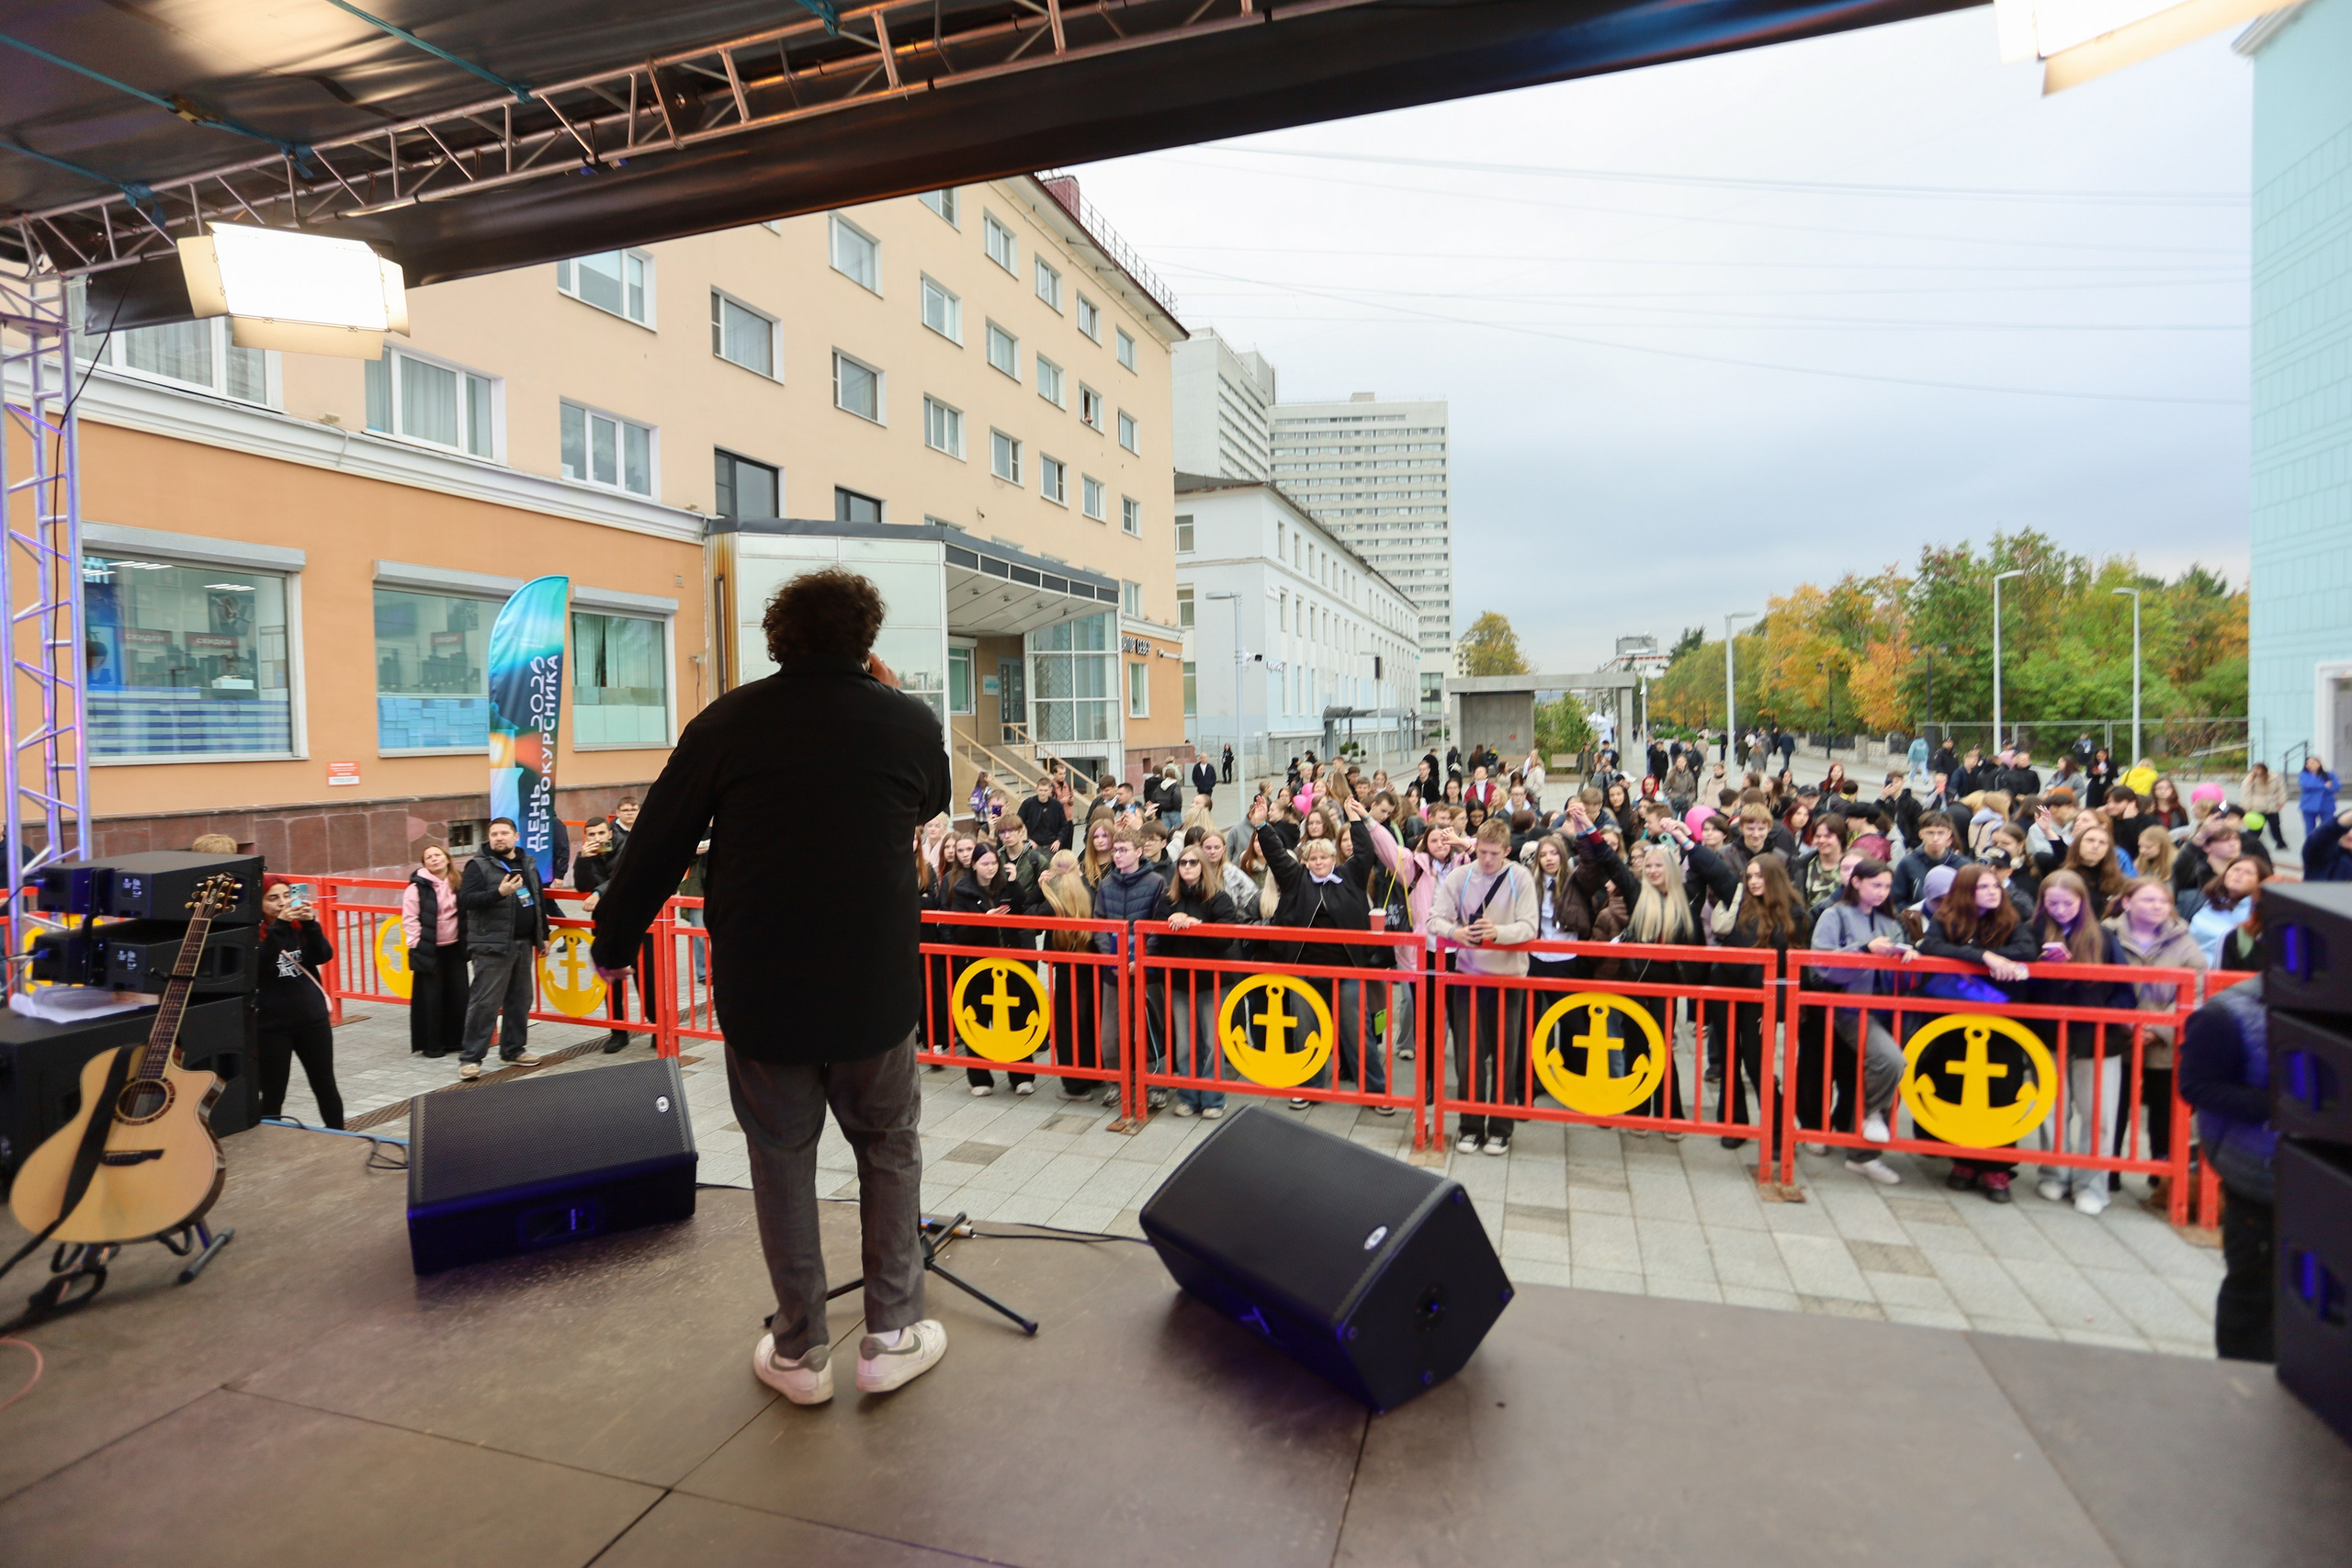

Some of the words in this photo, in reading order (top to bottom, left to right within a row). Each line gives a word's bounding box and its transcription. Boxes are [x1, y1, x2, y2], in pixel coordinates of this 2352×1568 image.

[125, 634, 164, 642] СКИДКИ
[530, 656, 546, 733] 2025
[538, 655, 559, 851] ПЕРВОКУРСНИКА
[526, 784, 541, 852] ДЕНЬ
